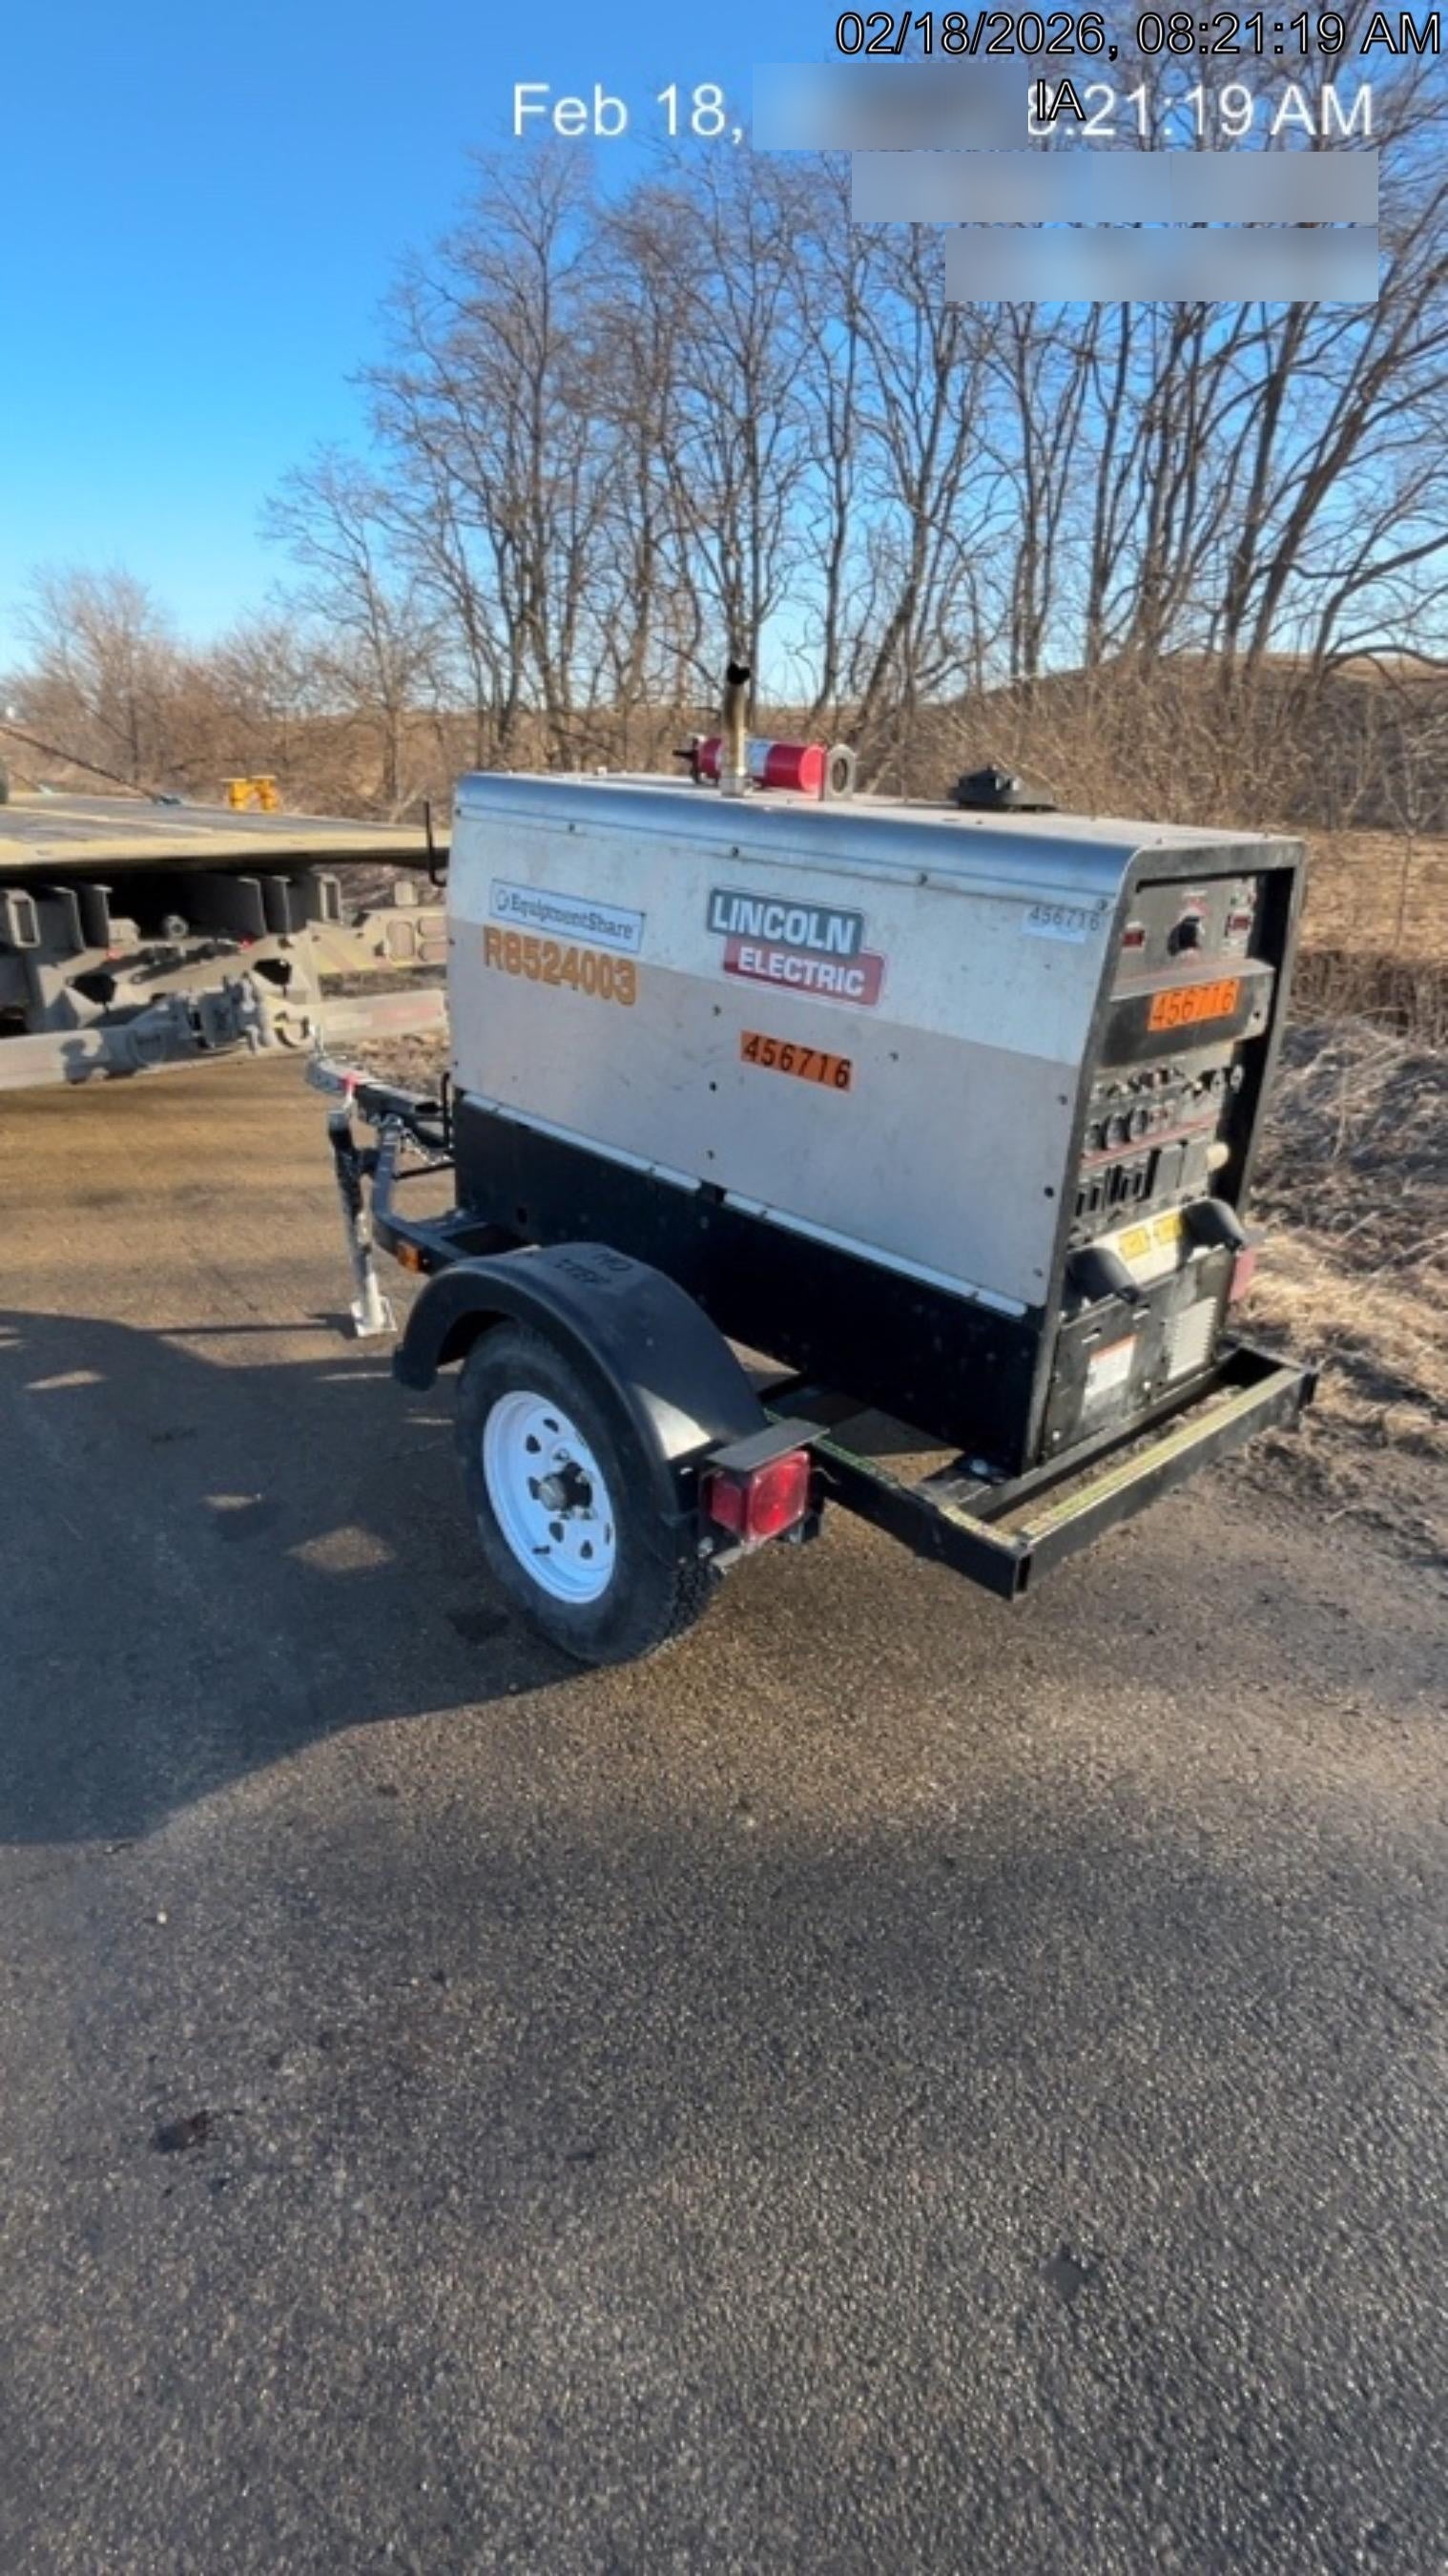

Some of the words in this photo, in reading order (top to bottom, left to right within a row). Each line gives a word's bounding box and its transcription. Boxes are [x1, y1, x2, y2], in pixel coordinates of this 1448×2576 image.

[510, 893, 634, 939] EquipmentShare
[713, 895, 856, 954] LINCOLN
[1028, 905, 1101, 931] 456716
[484, 925, 636, 1006] R8524003
[738, 946, 865, 997] ELECTRIC
[1152, 980, 1235, 1024] 456716
[744, 1035, 851, 1089] 456716
